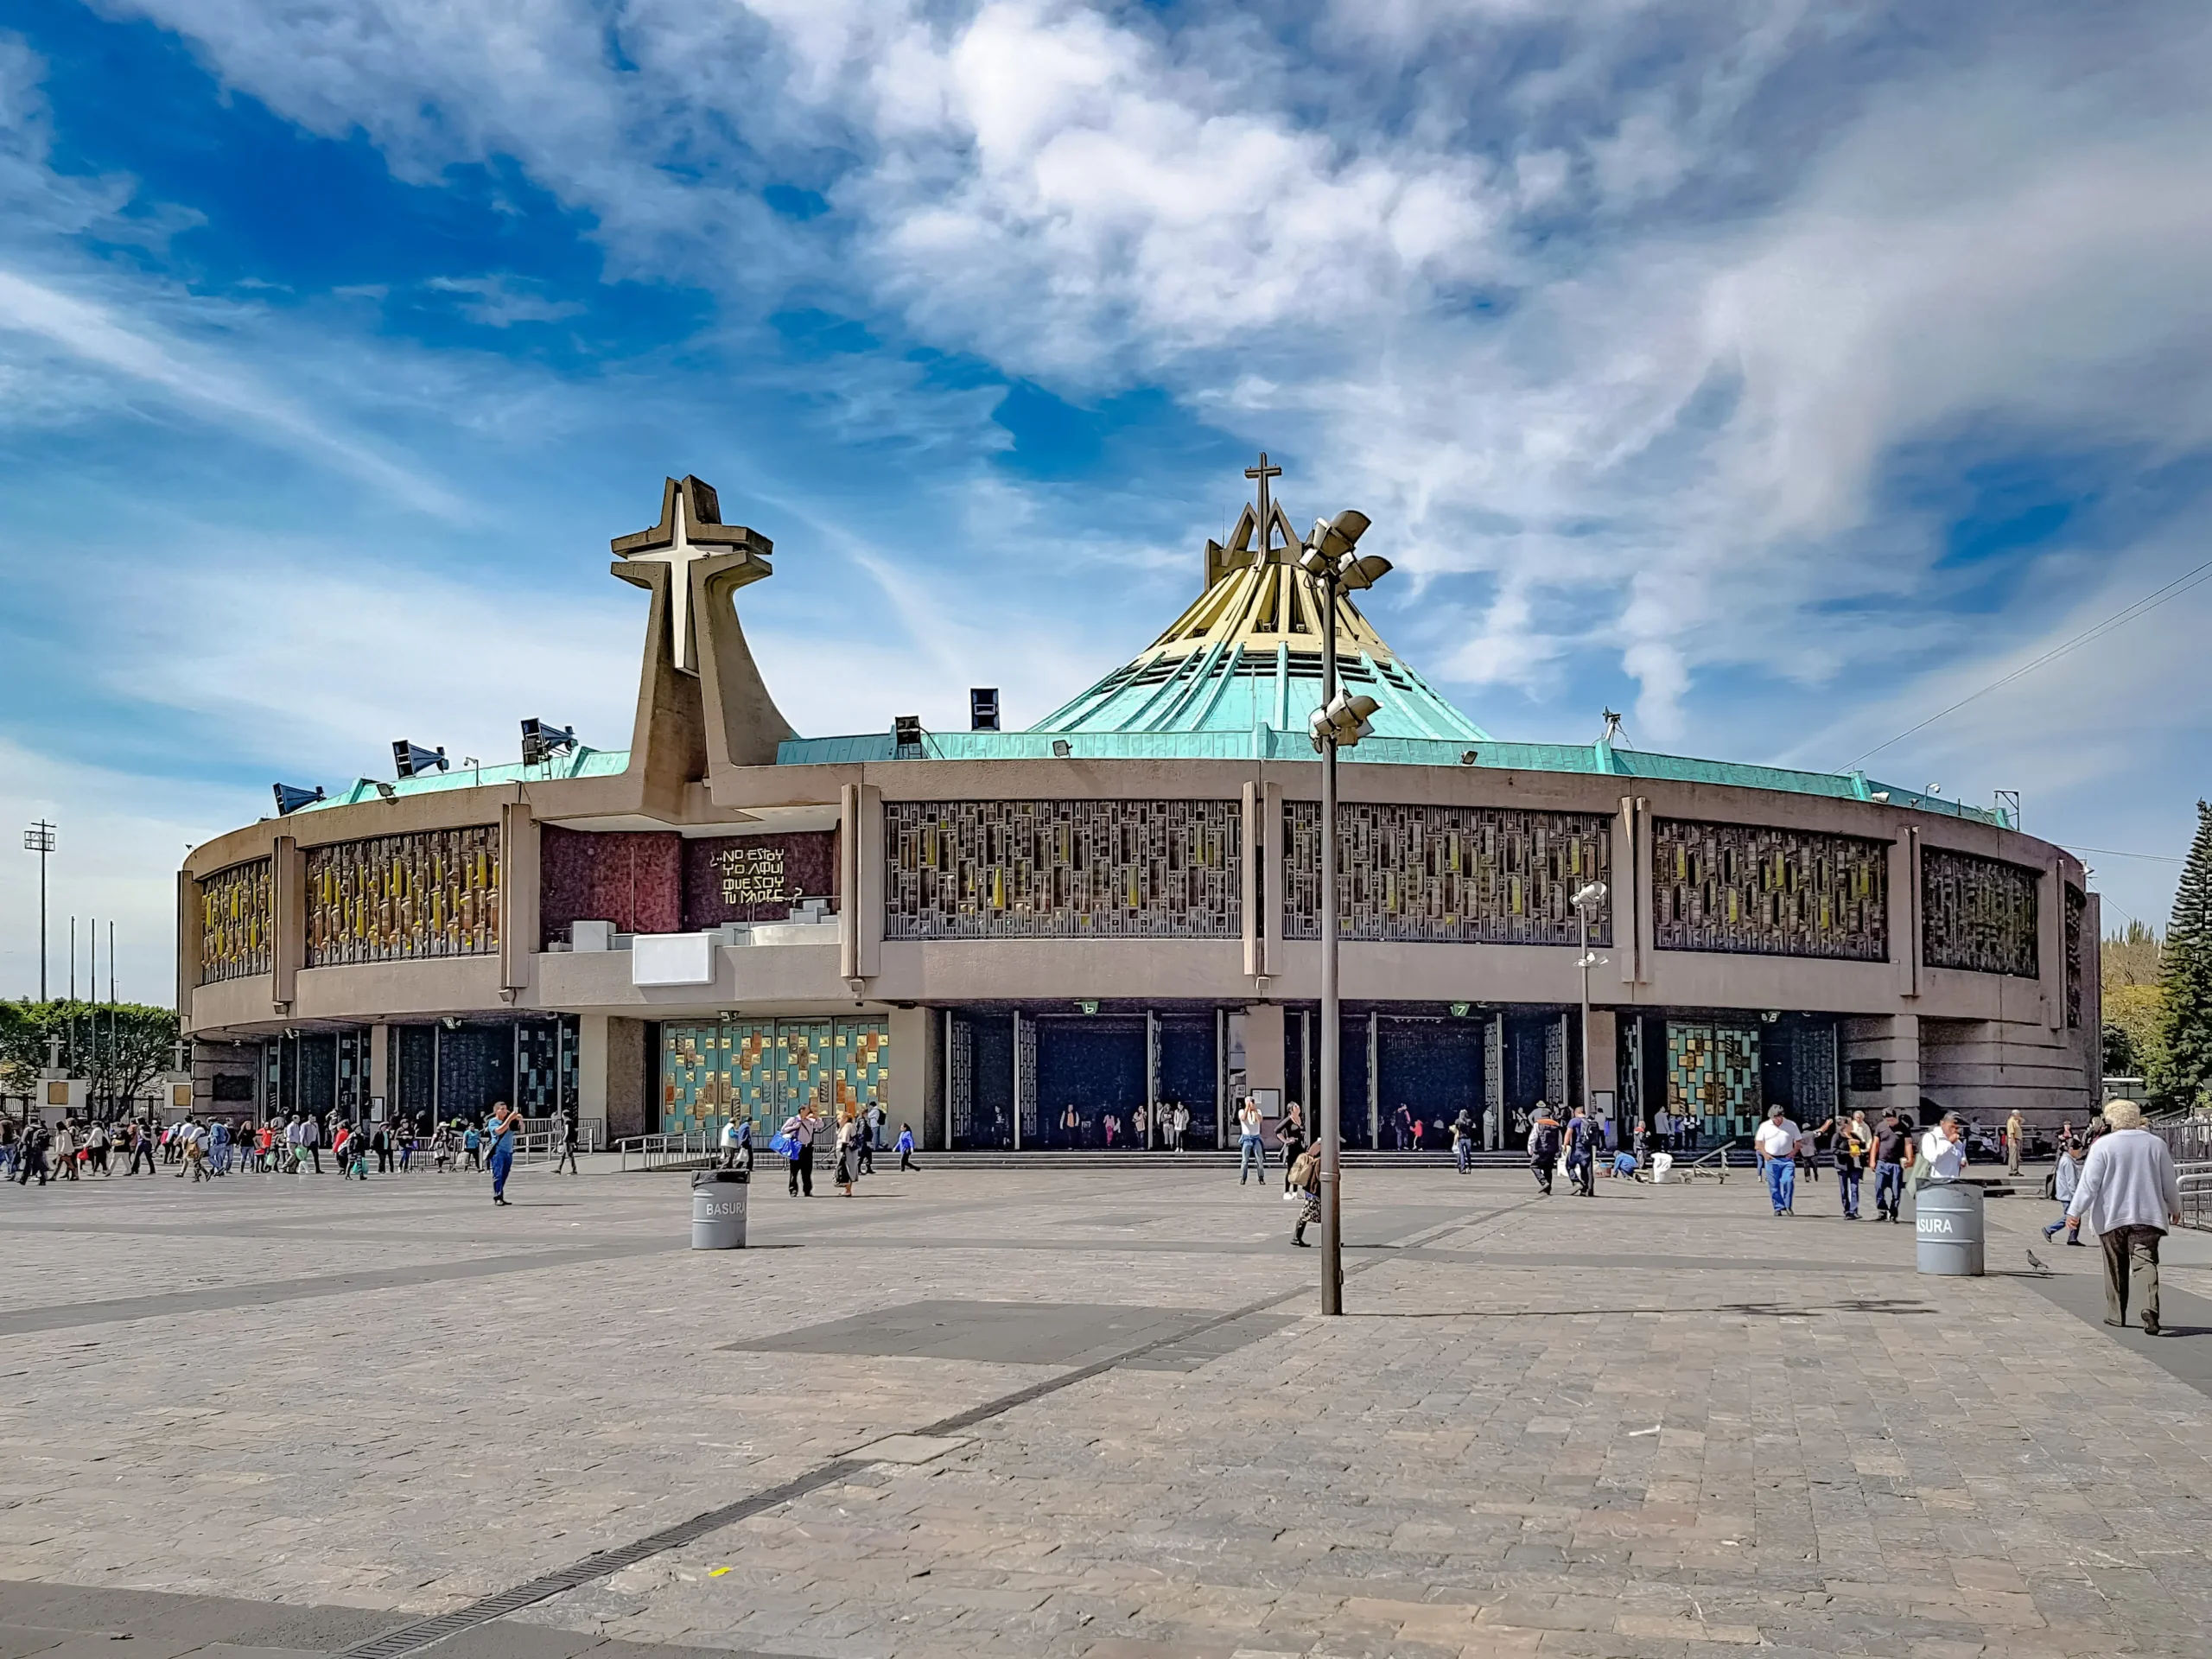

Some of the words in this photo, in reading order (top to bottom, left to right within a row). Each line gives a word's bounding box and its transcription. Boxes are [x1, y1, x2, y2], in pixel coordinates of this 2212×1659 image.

[723, 863, 745, 876] YO
[723, 878, 751, 891] QUE
[753, 875, 784, 889] SOY
[721, 890, 736, 905] TU
[721, 1011, 730, 1021] 5
[1458, 1006, 1466, 1016] 7
[1769, 1013, 1777, 1022] 8
